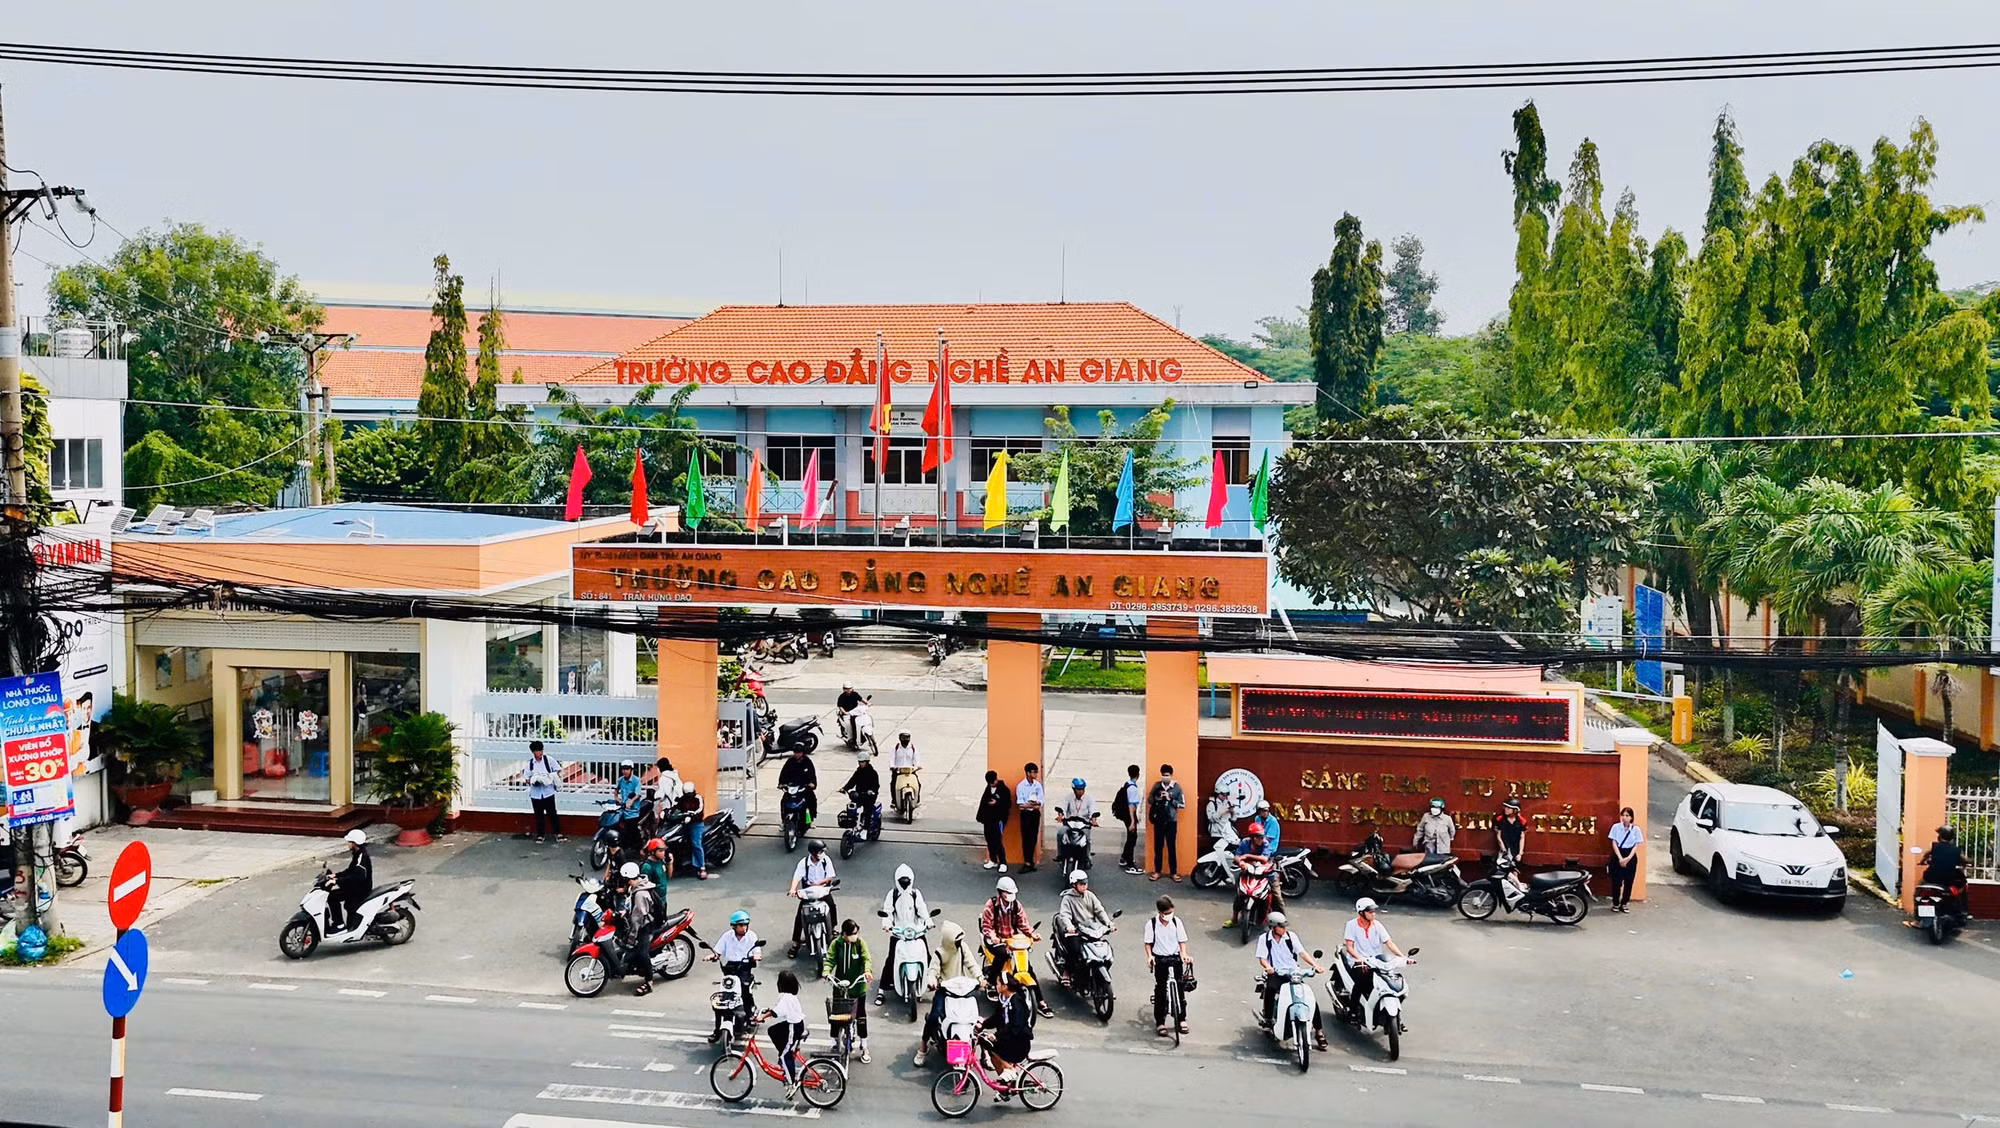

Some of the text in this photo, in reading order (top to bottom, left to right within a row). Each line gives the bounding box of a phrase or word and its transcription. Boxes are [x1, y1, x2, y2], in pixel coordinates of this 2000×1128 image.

[614, 354, 732, 384] TRƯỜNG
[746, 360, 812, 385] CAO
[1020, 359, 1065, 384] AN
[1079, 358, 1183, 383] GIANG
[48, 539, 103, 566] YAMAHA
[610, 563, 737, 591] TRƯỜNG
[757, 569, 819, 591] CAO
[1050, 574, 1094, 598] AN
[1113, 575, 1220, 600] GIANG
[2, 693, 58, 710] LONG CHÂU
[6, 688, 23, 699] NHÀ
[24, 683, 51, 696] THUỐC
[1300, 764, 1369, 791] SÁNG
[1504, 780, 1551, 799] TIN
[1273, 797, 1342, 824] NĂNG
